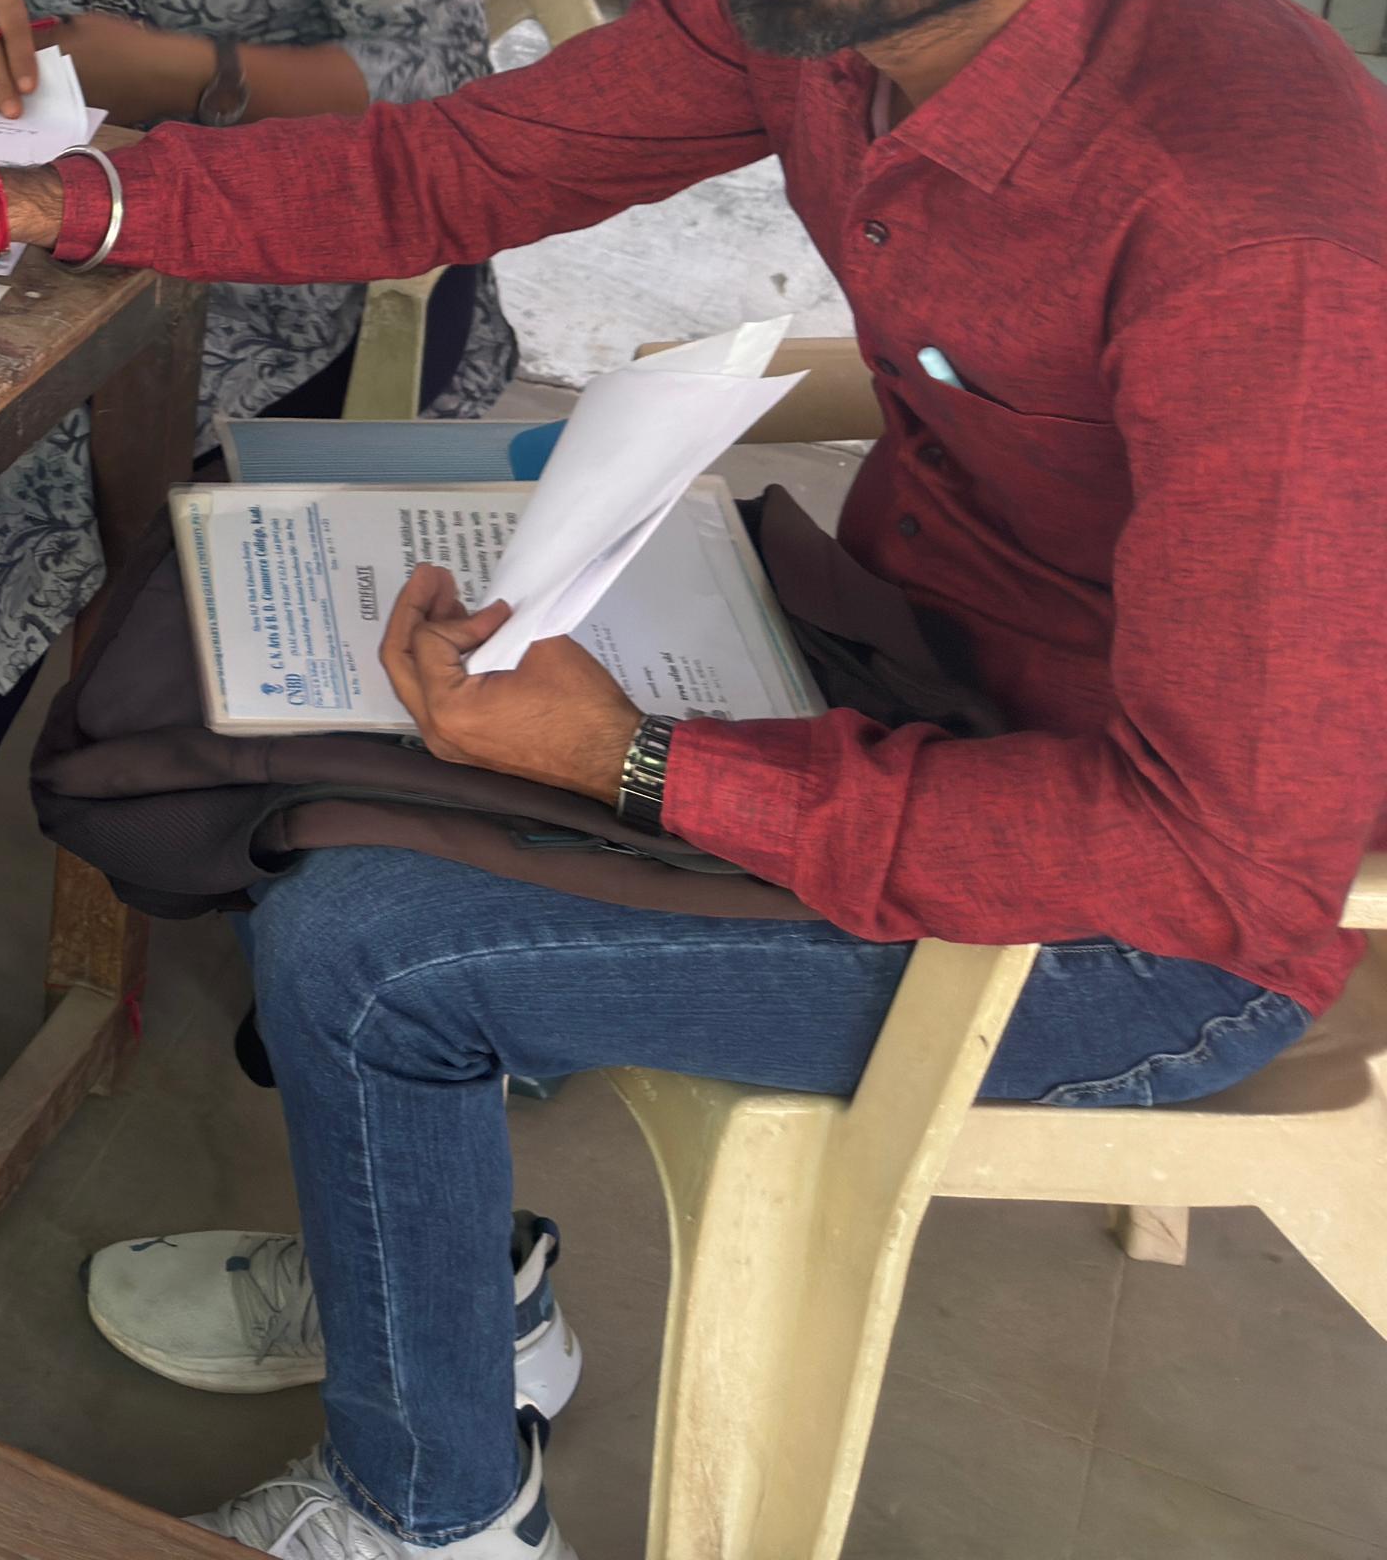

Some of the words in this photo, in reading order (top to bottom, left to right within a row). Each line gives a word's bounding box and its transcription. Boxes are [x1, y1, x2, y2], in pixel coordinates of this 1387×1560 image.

[251, 526, 267, 557] College,
[259, 559, 274, 600] Commerce
[355, 564, 377, 621] CERTIFICATE
[263, 603, 275, 611] D.
[264, 614, 277, 622] B.
[267, 632, 280, 648] Arts
[269, 650, 282, 659] N.
[285, 673, 306, 706] CNBD
